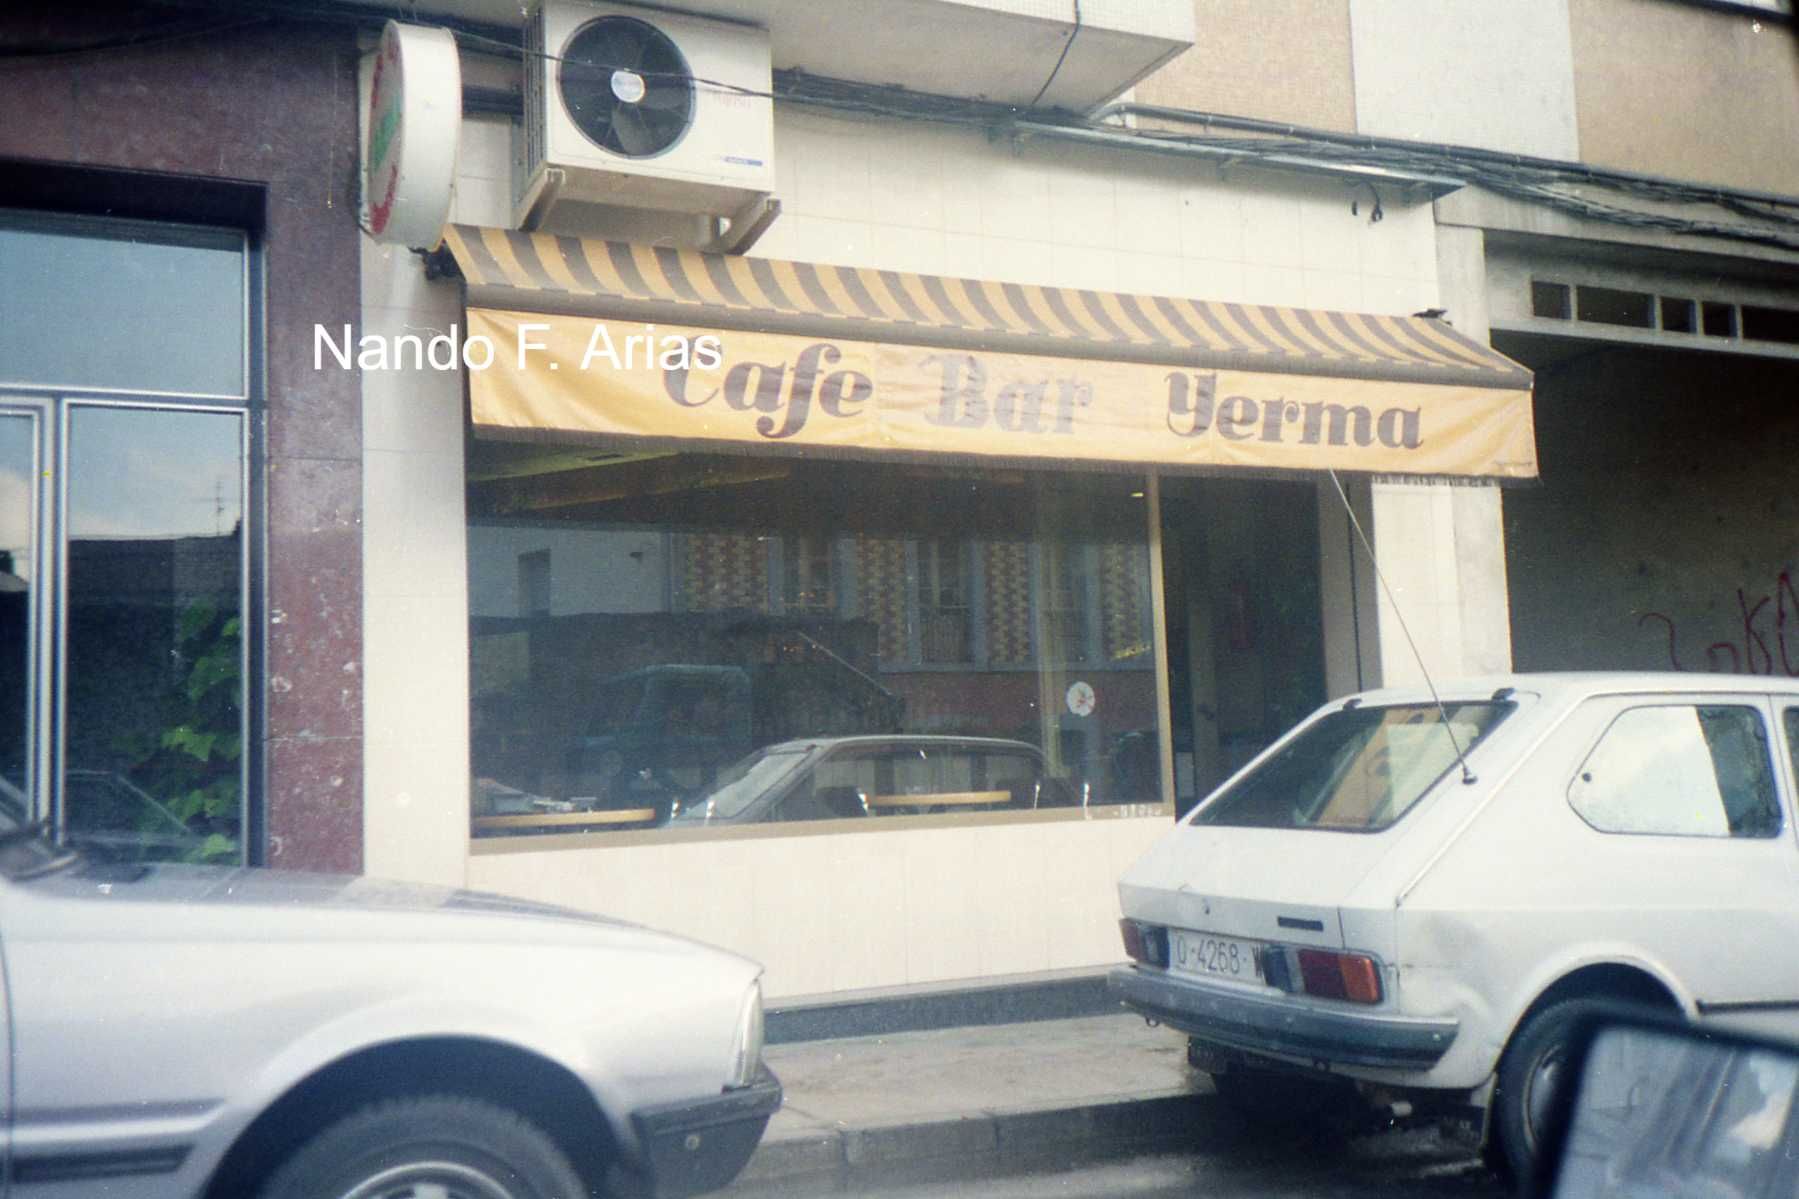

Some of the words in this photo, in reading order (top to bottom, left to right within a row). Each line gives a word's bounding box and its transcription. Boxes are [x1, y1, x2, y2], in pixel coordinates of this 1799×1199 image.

[664, 338, 872, 439] Cafe
[920, 353, 1093, 434] Bar
[1164, 370, 1424, 450] Yerma
